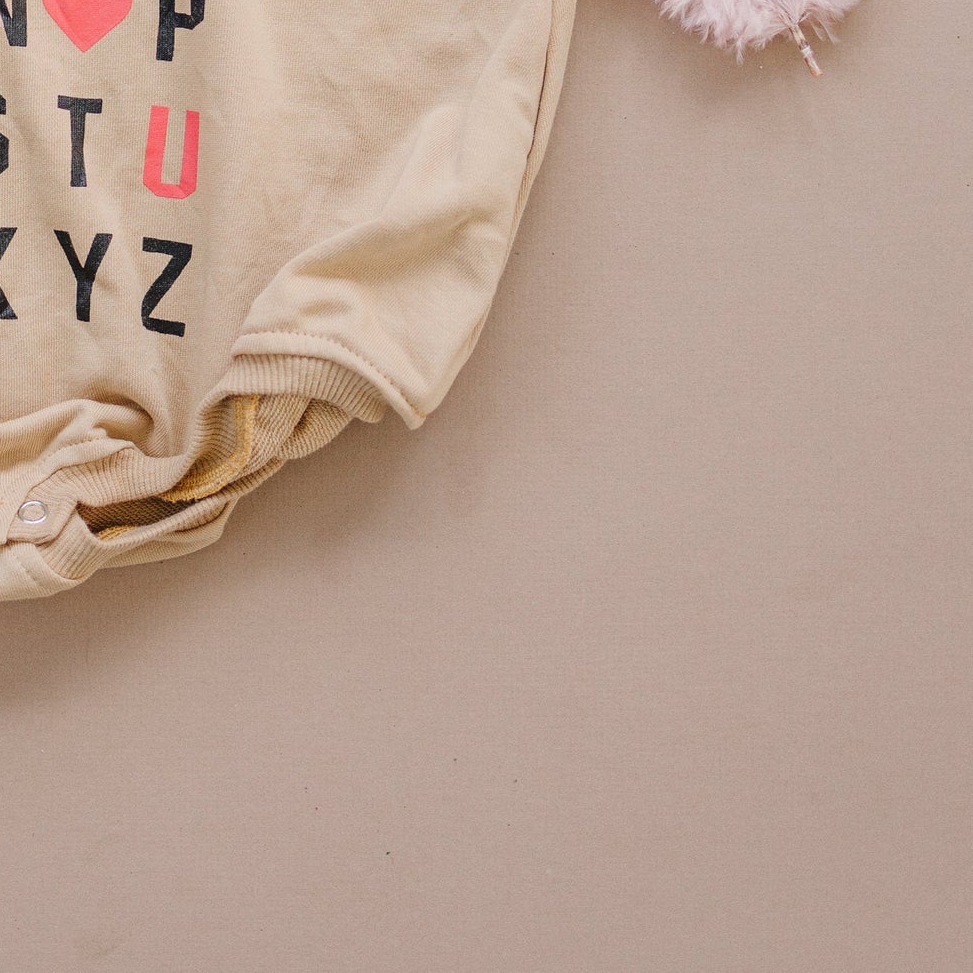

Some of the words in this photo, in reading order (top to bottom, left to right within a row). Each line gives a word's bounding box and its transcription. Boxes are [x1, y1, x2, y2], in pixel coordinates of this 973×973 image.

[57, 94, 103, 188] T
[142, 104, 201, 200] U
[53, 229, 113, 323] Y
[140, 236, 193, 338] Z
